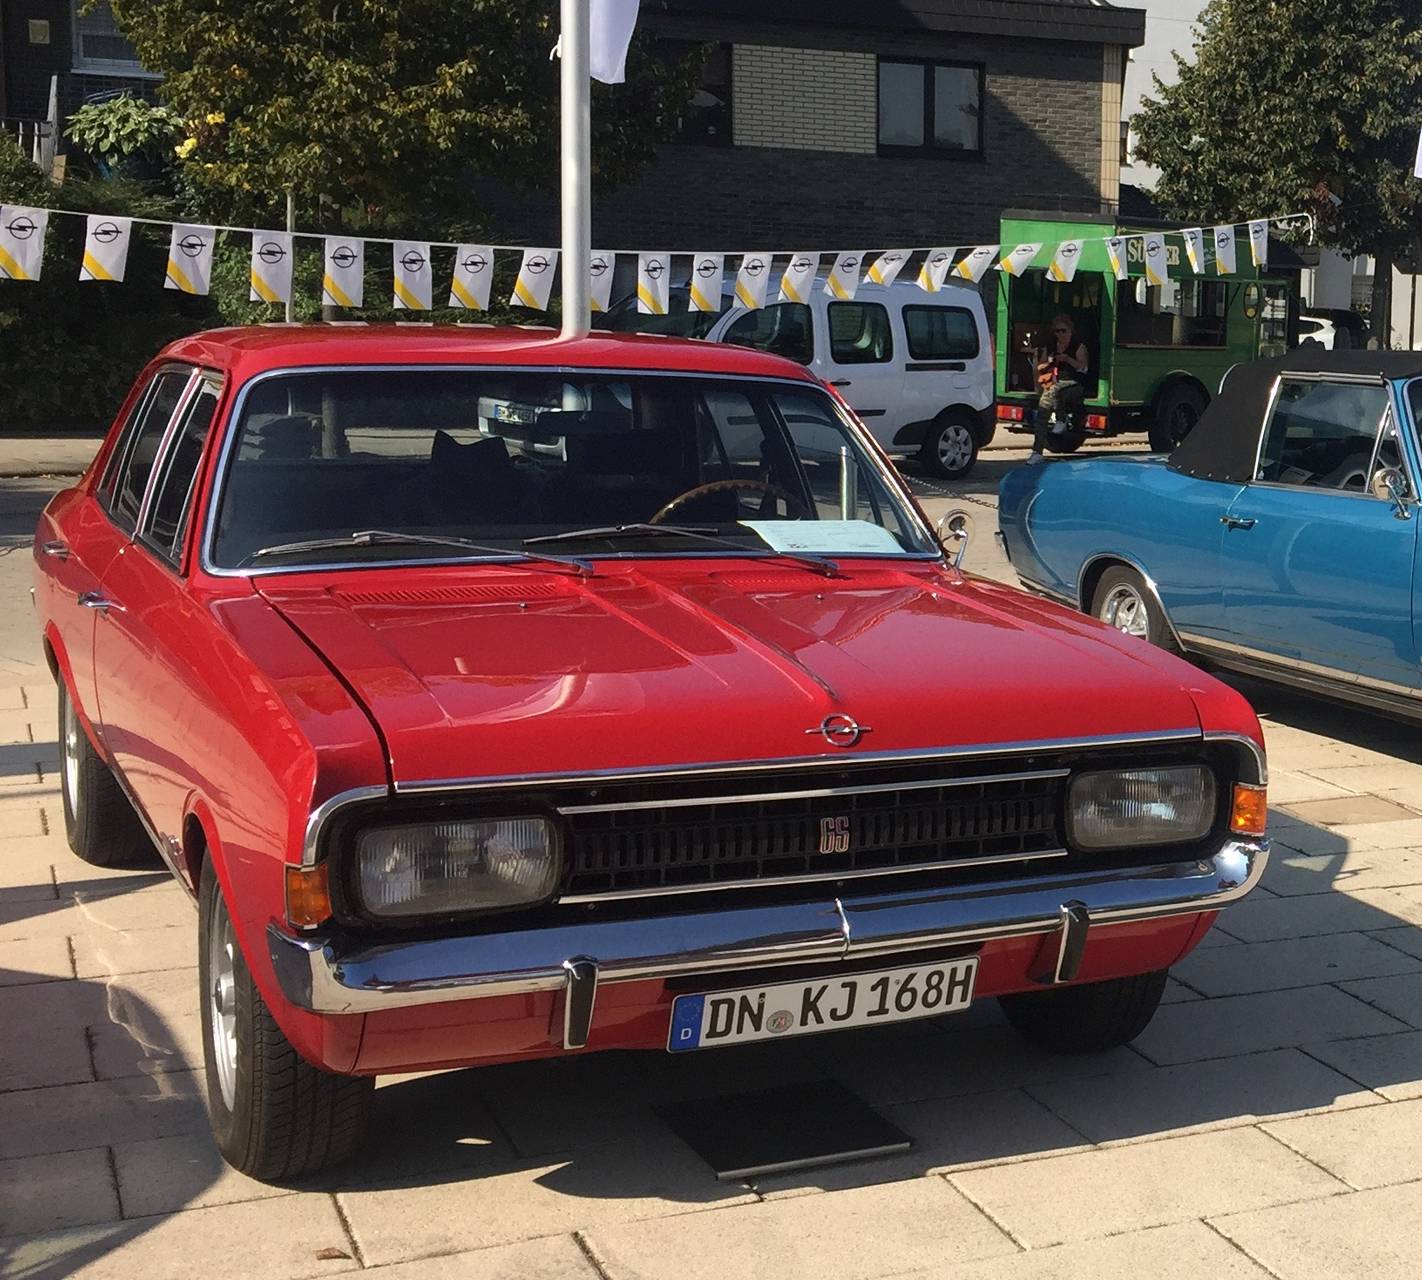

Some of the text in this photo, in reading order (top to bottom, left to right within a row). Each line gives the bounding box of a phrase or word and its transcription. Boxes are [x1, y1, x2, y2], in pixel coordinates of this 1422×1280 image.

[820, 815, 850, 855] GS
[680, 964, 974, 1040] D DN KJ 168H
